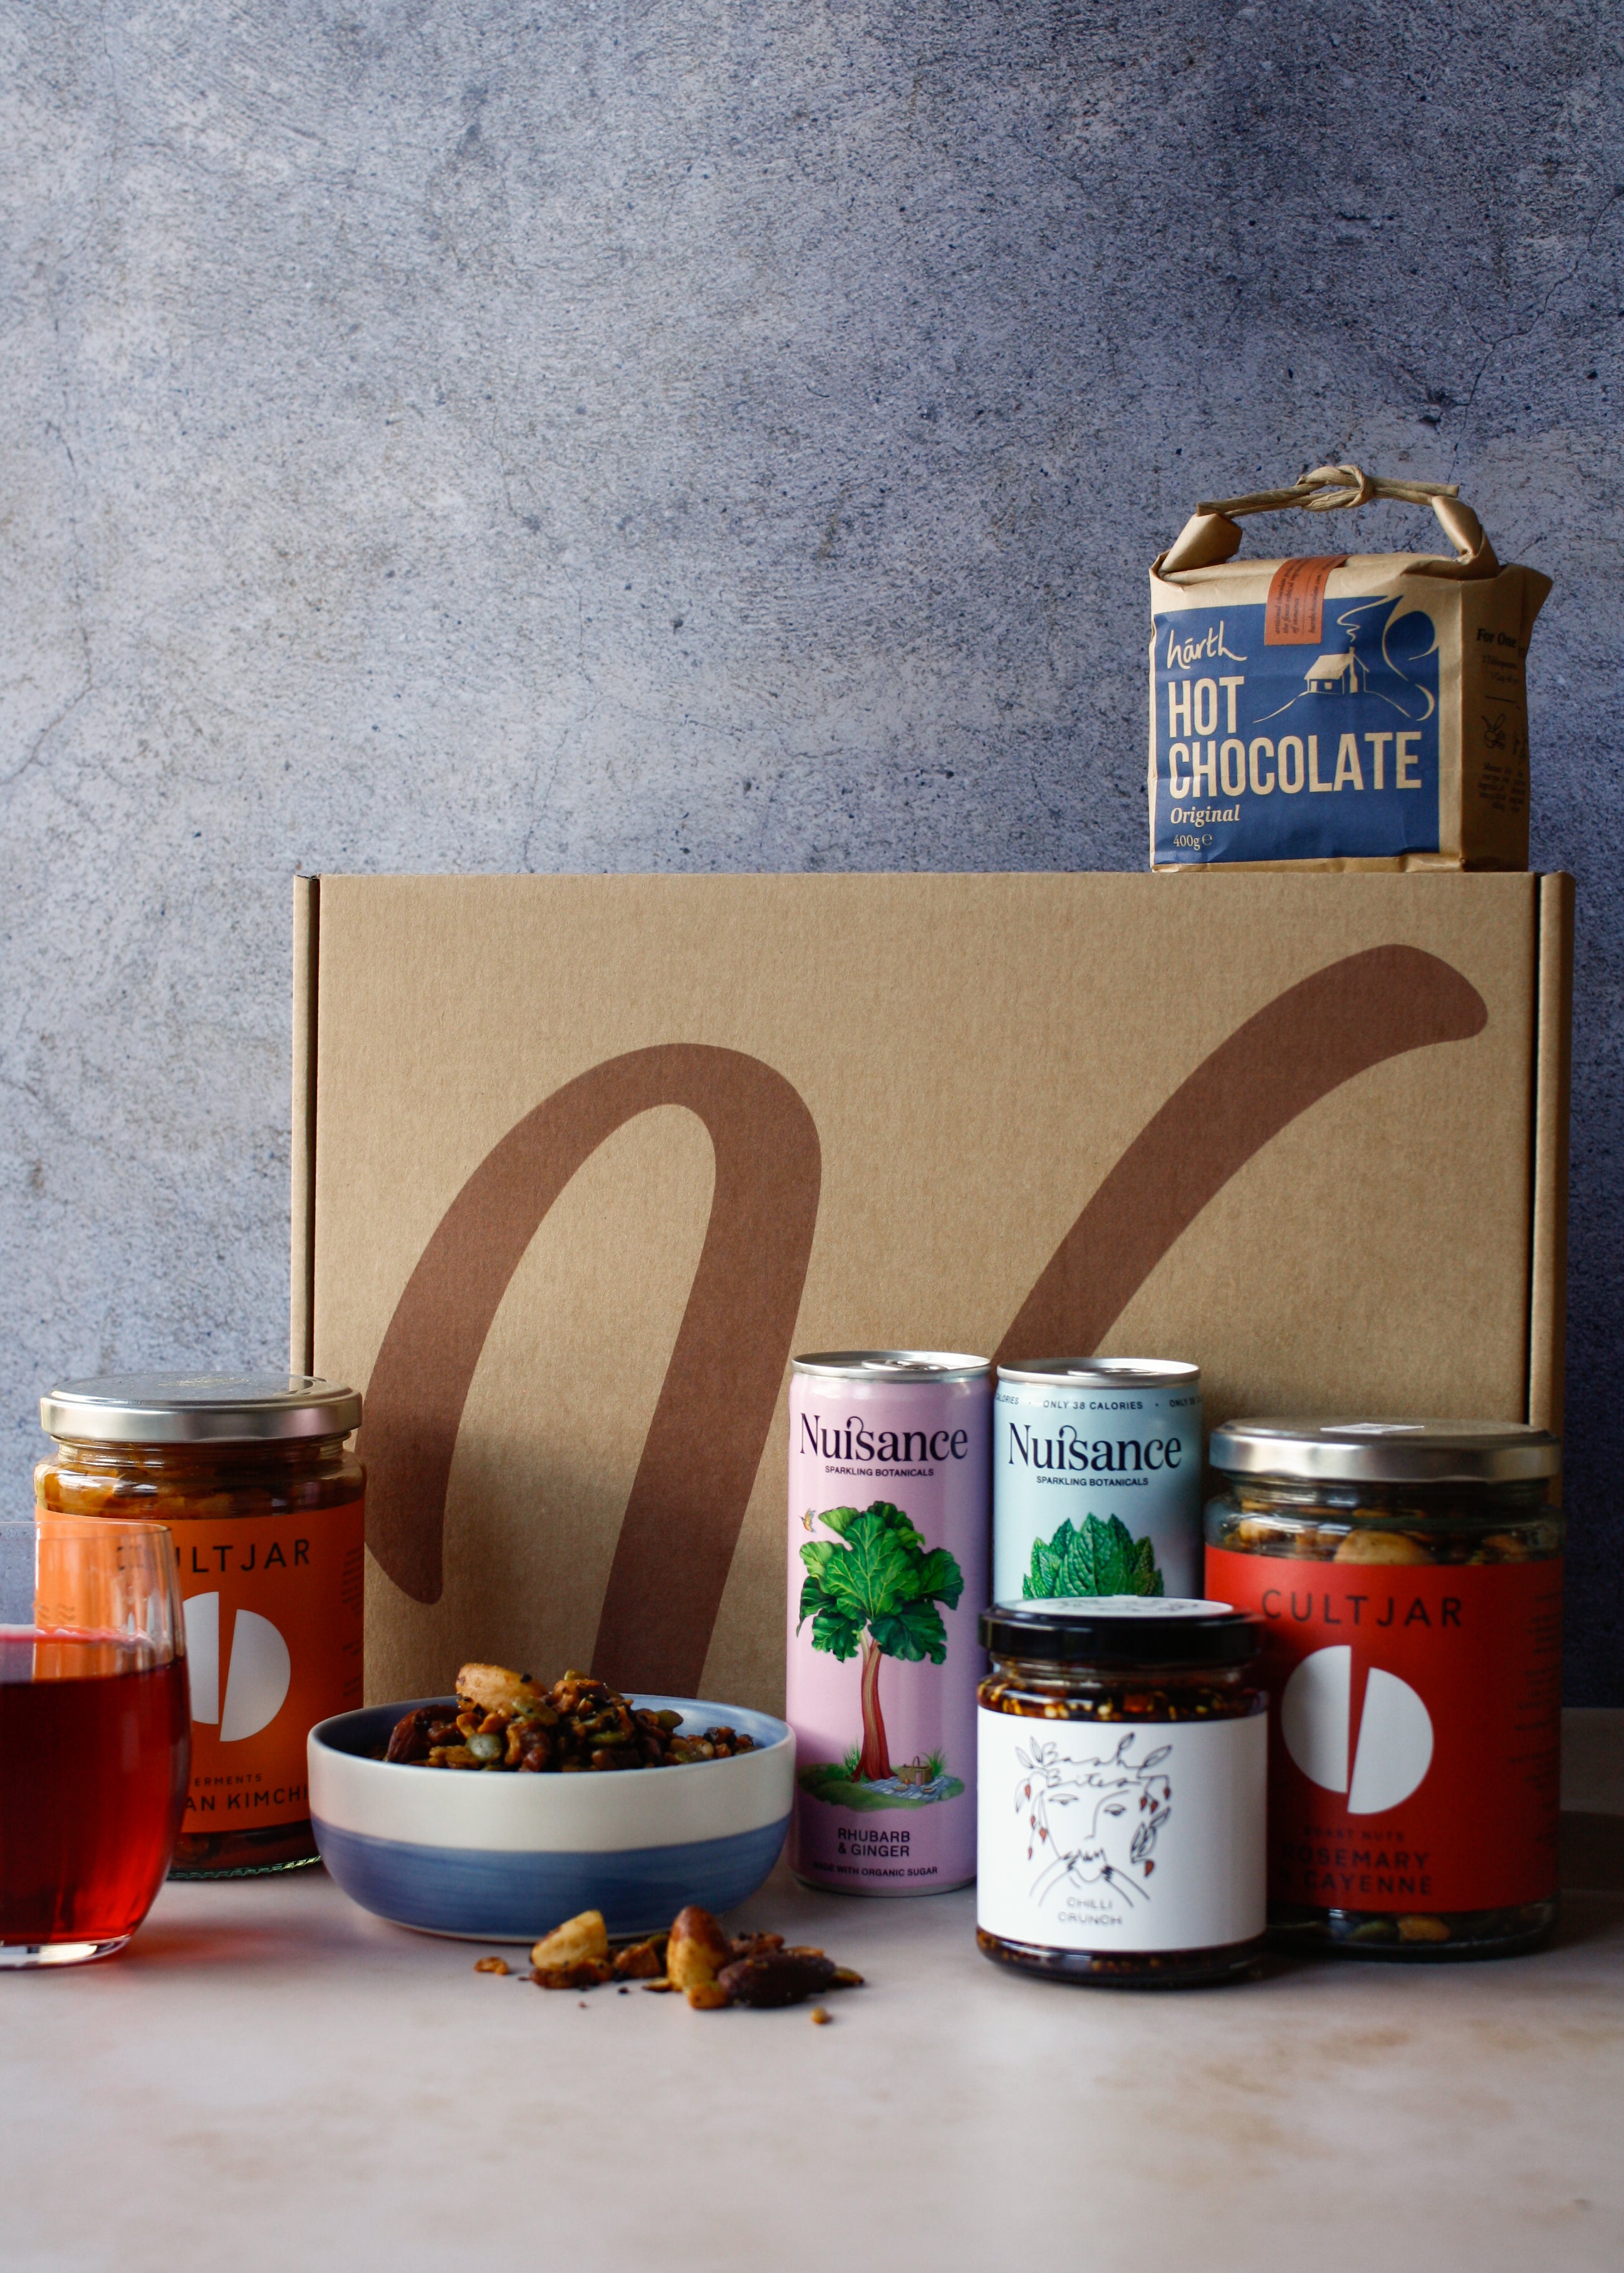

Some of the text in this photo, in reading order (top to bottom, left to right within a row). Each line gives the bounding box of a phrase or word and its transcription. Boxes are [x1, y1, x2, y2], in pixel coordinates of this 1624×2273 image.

[1476, 628, 1517, 648] For One
[1168, 676, 1244, 738] HOT
[1169, 731, 1422, 799] CHOCOLATE
[1170, 804, 1241, 828] Original
[1173, 835, 1201, 851] 400g
[1043, 1400, 1143, 1410] ONLY 38 CALORIES
[800, 1413, 968, 1462] Nuisance
[1009, 1422, 1182, 1471] Nuisance
[825, 1465, 934, 1477] SPARKLING BOTANICALS
[1036, 1475, 1148, 1487] SPARKLING BOTANICALS
[1262, 1589, 1462, 1627] CULTJAR
[195, 1774, 262, 1786] ERMENTS
[227, 1784, 307, 1809] KIMCHI
[838, 1828, 910, 1843] RHUBARB
[838, 1843, 910, 1857] & GINGER
[1282, 1842, 1429, 1870] ROSEMARY
[836, 1865, 859, 1875] WITH
[861, 1868, 905, 1877] ORGANIC
[907, 1866, 937, 1876] SUGAR
[1304, 1870, 1432, 1895] CAYENNE
[1066, 1896, 1113, 1909] CHILLI
[1058, 1911, 1123, 1925] CRUNCH
